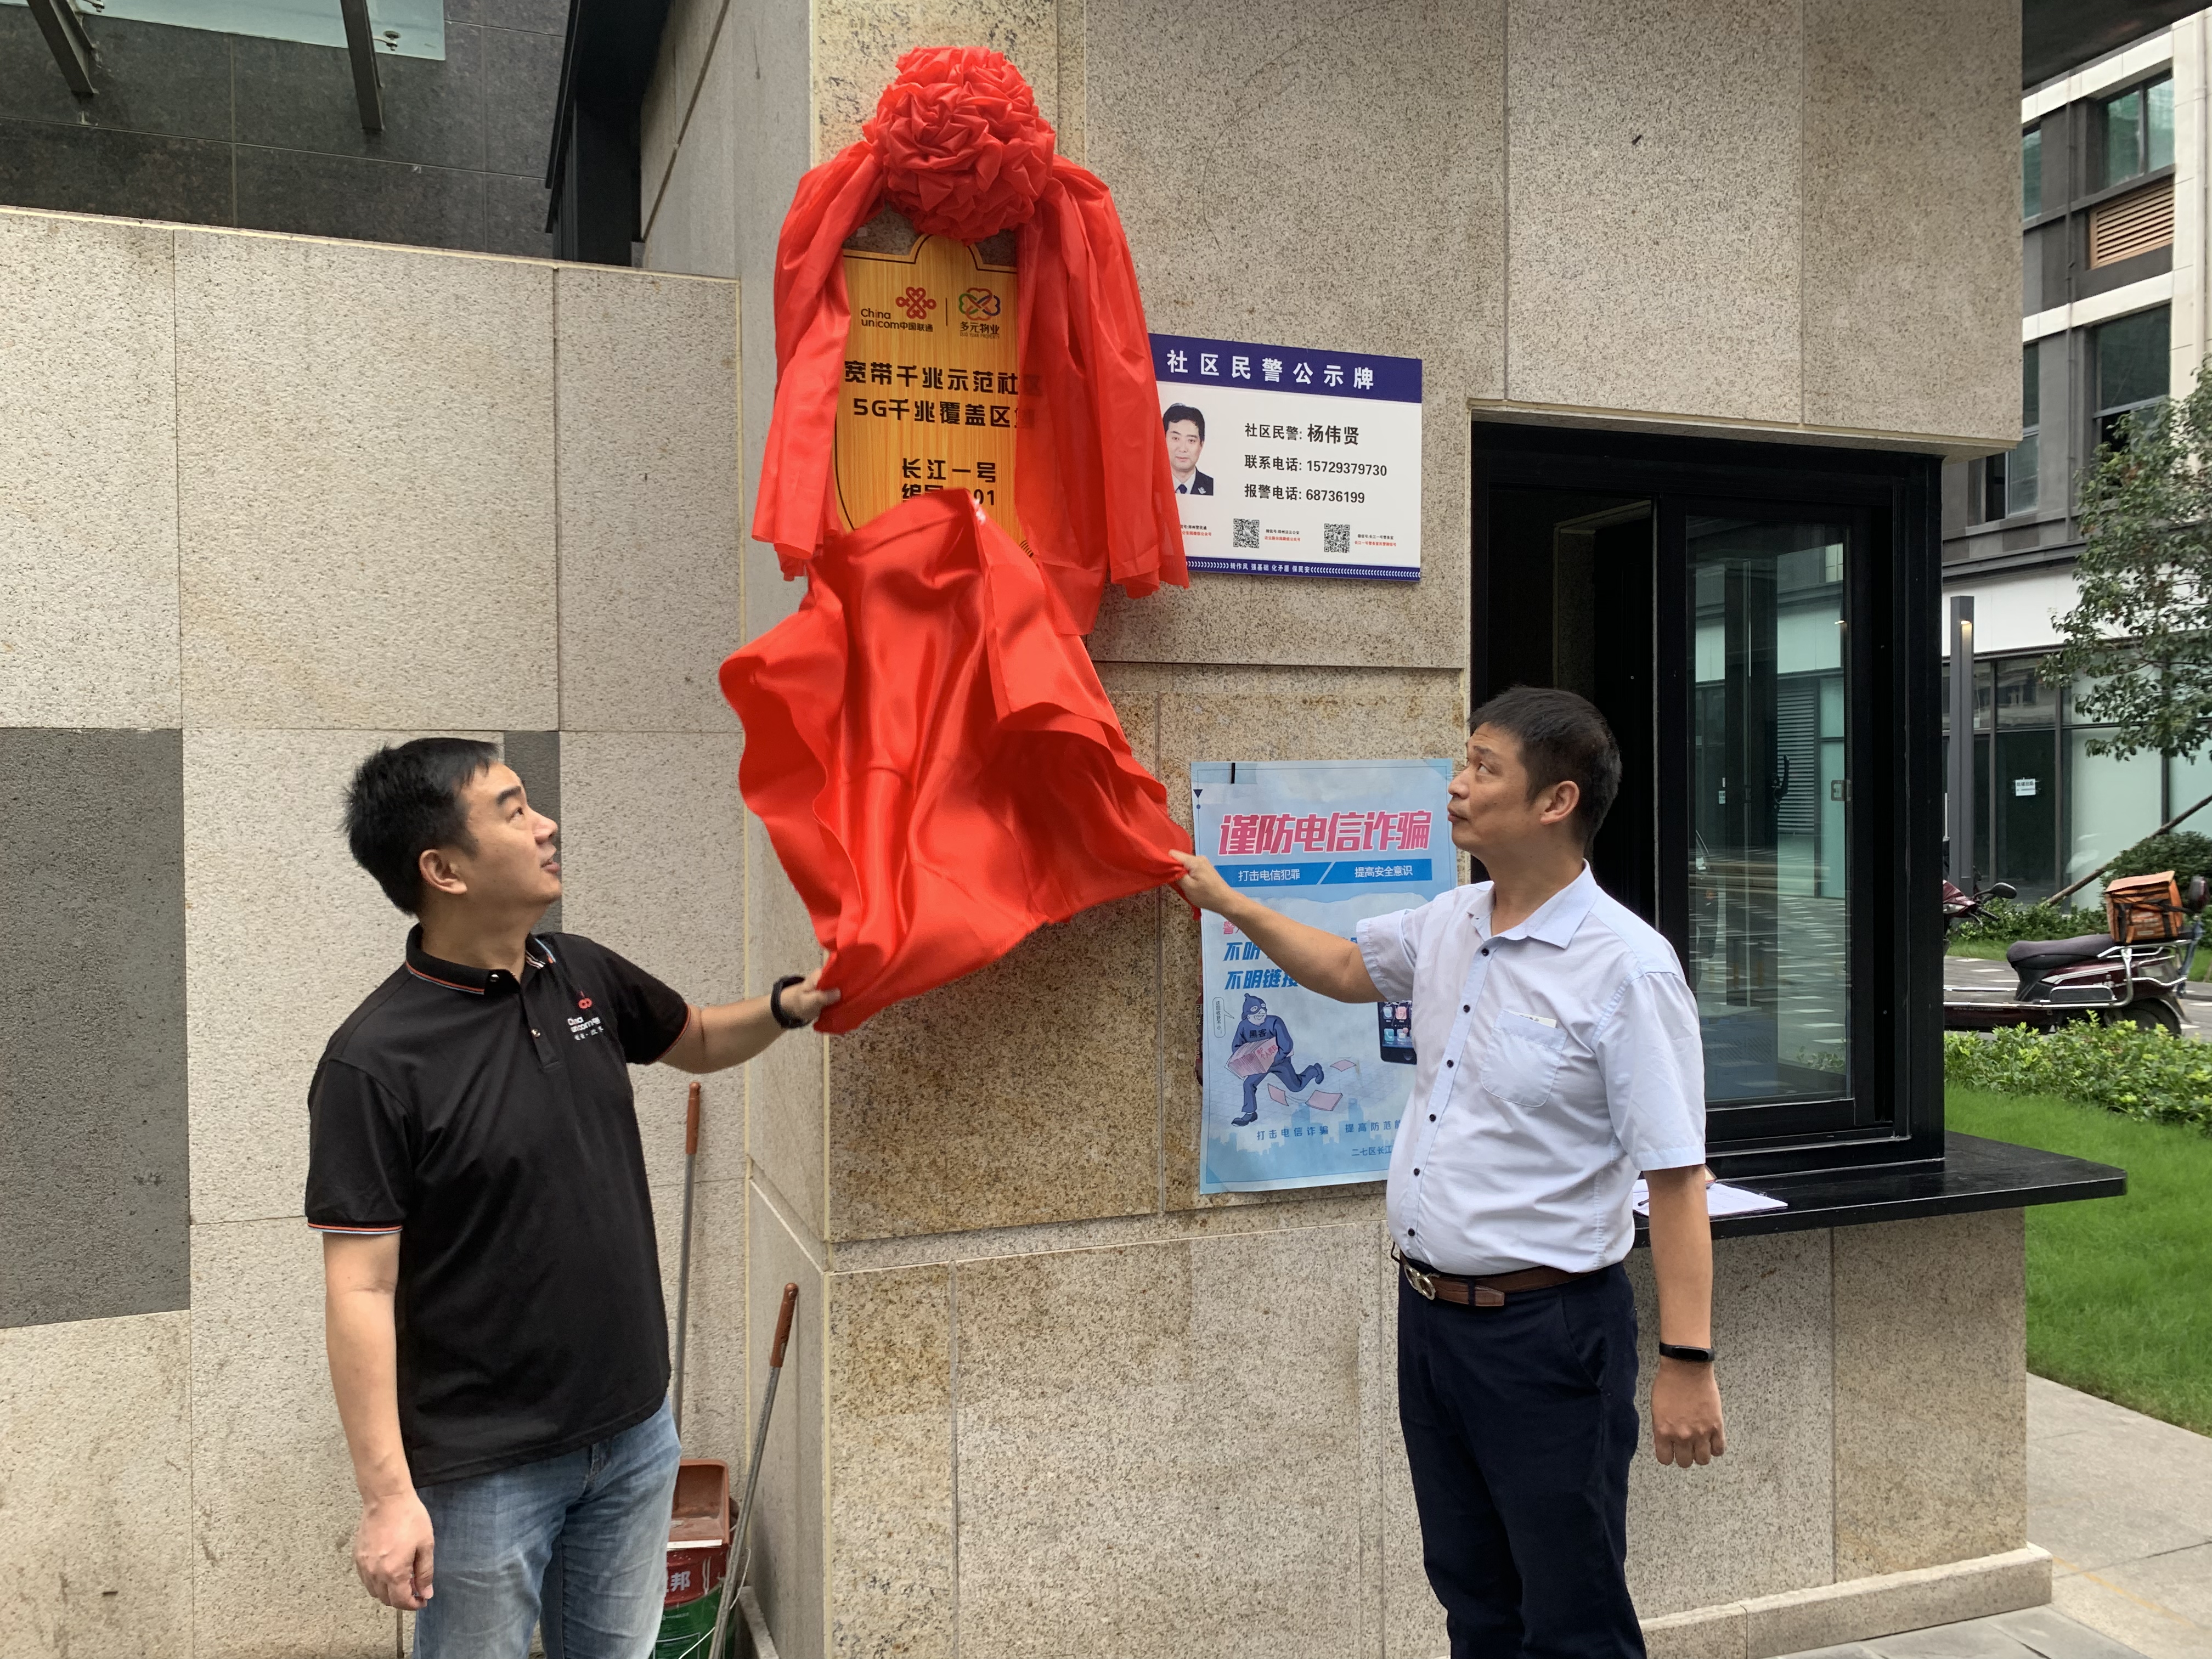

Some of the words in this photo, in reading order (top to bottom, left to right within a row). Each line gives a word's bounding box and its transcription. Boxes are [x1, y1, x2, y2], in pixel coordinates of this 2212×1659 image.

[861, 308, 891, 319] China
[861, 319, 900, 330] unicom
[900, 321, 933, 332] 中国联通
[960, 321, 1000, 335] 多元物业
[1167, 349, 1374, 390] 社区民警公示牌
[1307, 424, 1359, 445] 杨伟贤
[902, 458, 996, 483] 长江一号
[1306, 459, 1387, 477] 15729379730
[1306, 488, 1365, 504] 68736199
[1230, 562, 1249, 571] 转作风
[1251, 563, 1269, 572] 强基础
[1292, 565, 1310, 573] 保民安
[1217, 810, 1432, 856] 谨防电信诈骗
[1238, 868, 1301, 882] 打击电信犯罪
[1354, 865, 1413, 878] 提高安全意识
[1249, 1029, 1267, 1038] 黑客
[1257, 1126, 1329, 1140] 打击电信诈骗
[1351, 1144, 1392, 1156] 二七区长江
